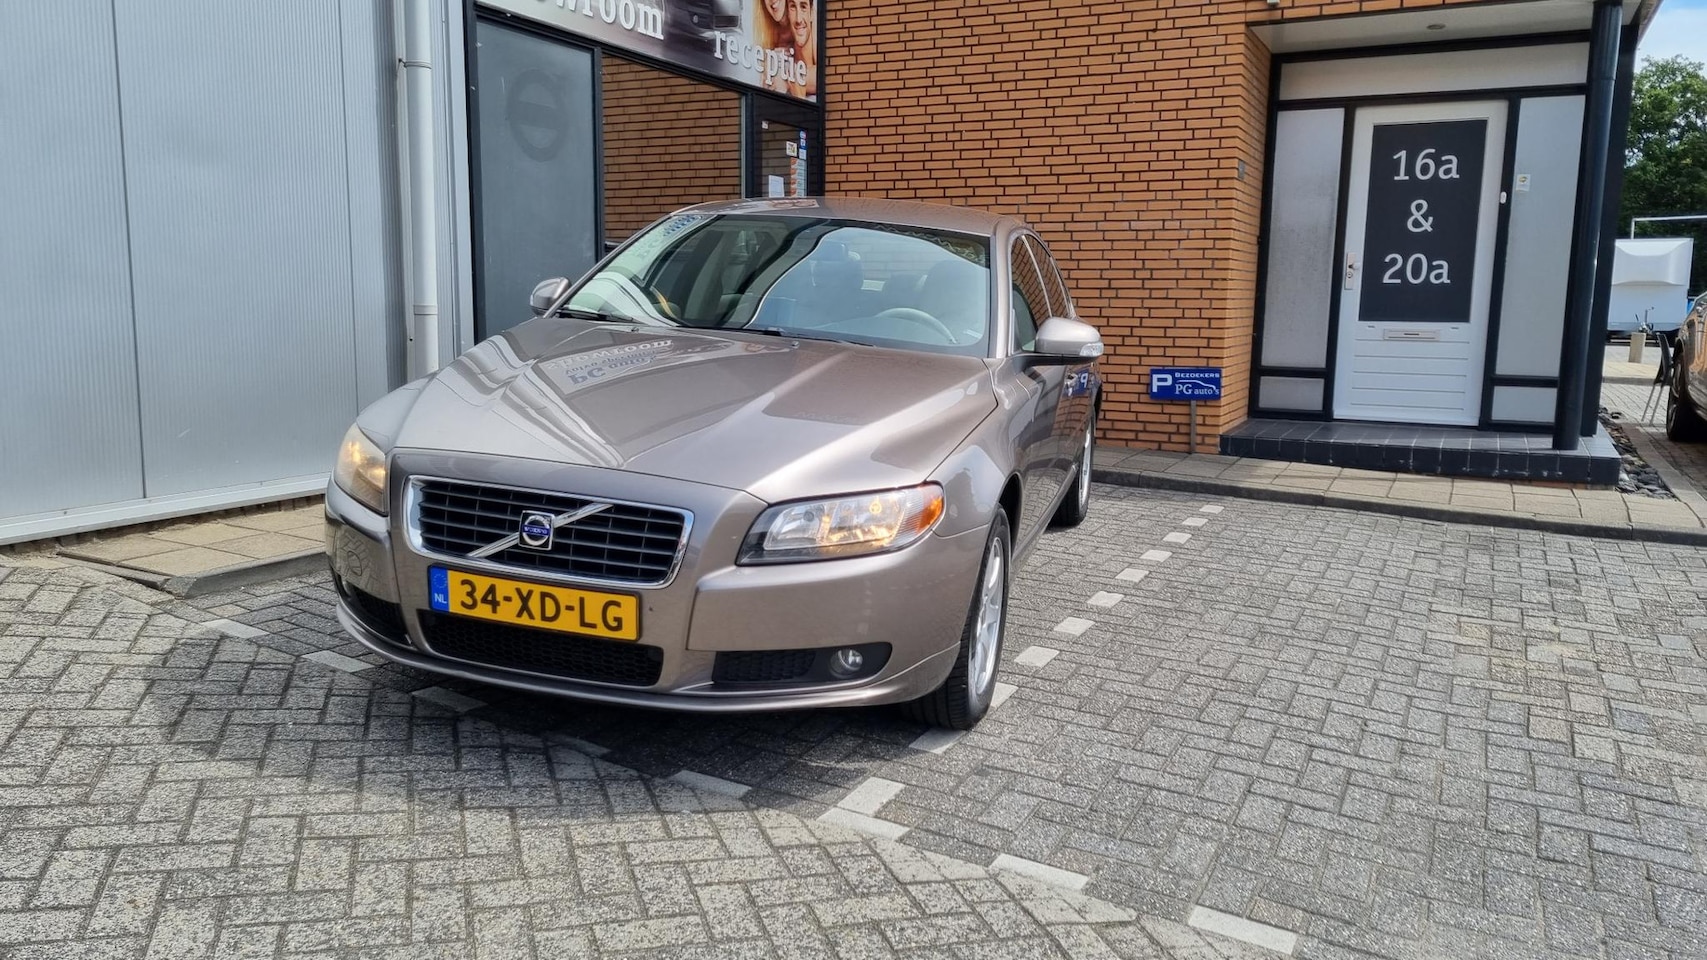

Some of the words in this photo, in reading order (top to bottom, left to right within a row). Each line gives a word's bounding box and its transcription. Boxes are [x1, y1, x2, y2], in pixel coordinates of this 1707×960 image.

[538, 0, 664, 40] room
[713, 30, 807, 88] receptie
[1392, 148, 1460, 181] 16a
[1406, 199, 1434, 233] &
[1382, 253, 1451, 285] 20a
[1152, 374, 1173, 393] P
[1175, 384, 1193, 395] PG
[1194, 387, 1220, 395] auto's
[524, 526, 548, 535] VOLVO
[434, 592, 448, 605] NL
[460, 578, 623, 633] 34-XD-LG
